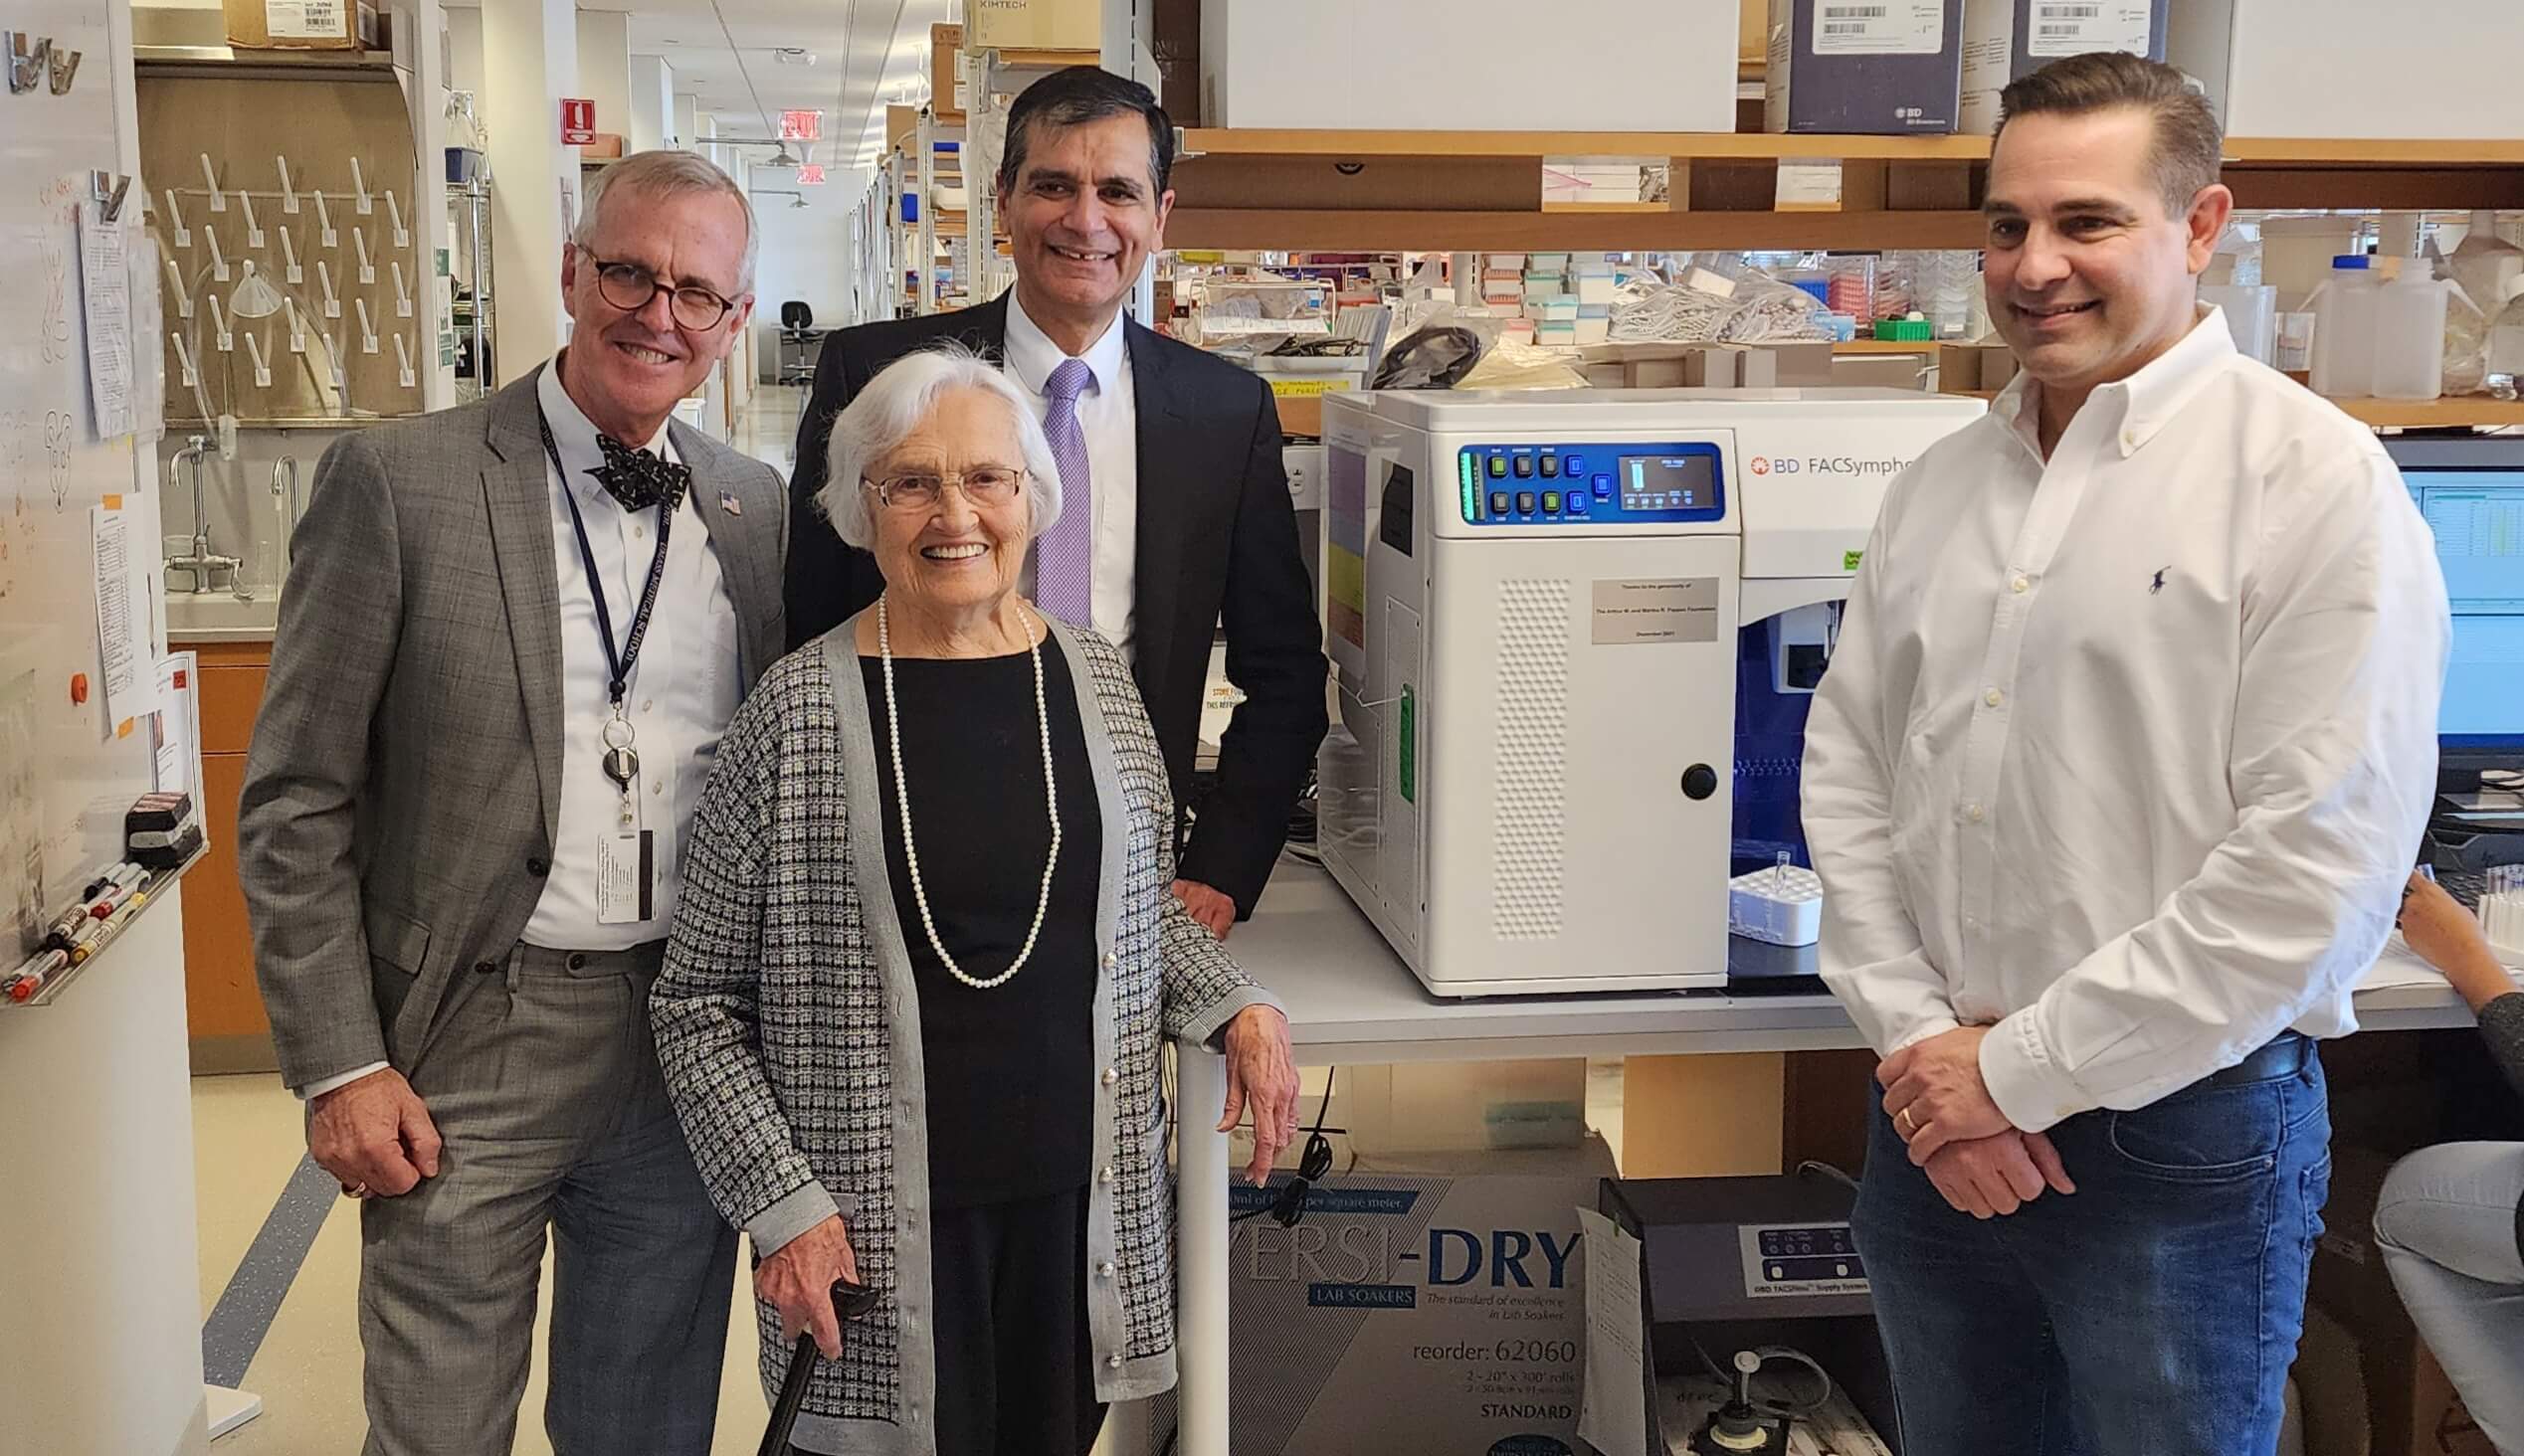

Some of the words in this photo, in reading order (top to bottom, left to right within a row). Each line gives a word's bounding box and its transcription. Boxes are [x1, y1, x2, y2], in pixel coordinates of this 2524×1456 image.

[1774, 458, 1801, 474] BD
[641, 574, 660, 619] MEDICAL
[1317, 1289, 1343, 1303] LAB
[1349, 1289, 1414, 1304] SOAKERS
[1428, 1293, 1445, 1305] The
[1448, 1293, 1493, 1306] standard
[1496, 1293, 1509, 1308] of
[1509, 1295, 1565, 1308] excellence
[1413, 1340, 1490, 1362] reorder:
[1495, 1340, 1577, 1363] 62060
[1480, 1403, 1573, 1420] STANDARD
